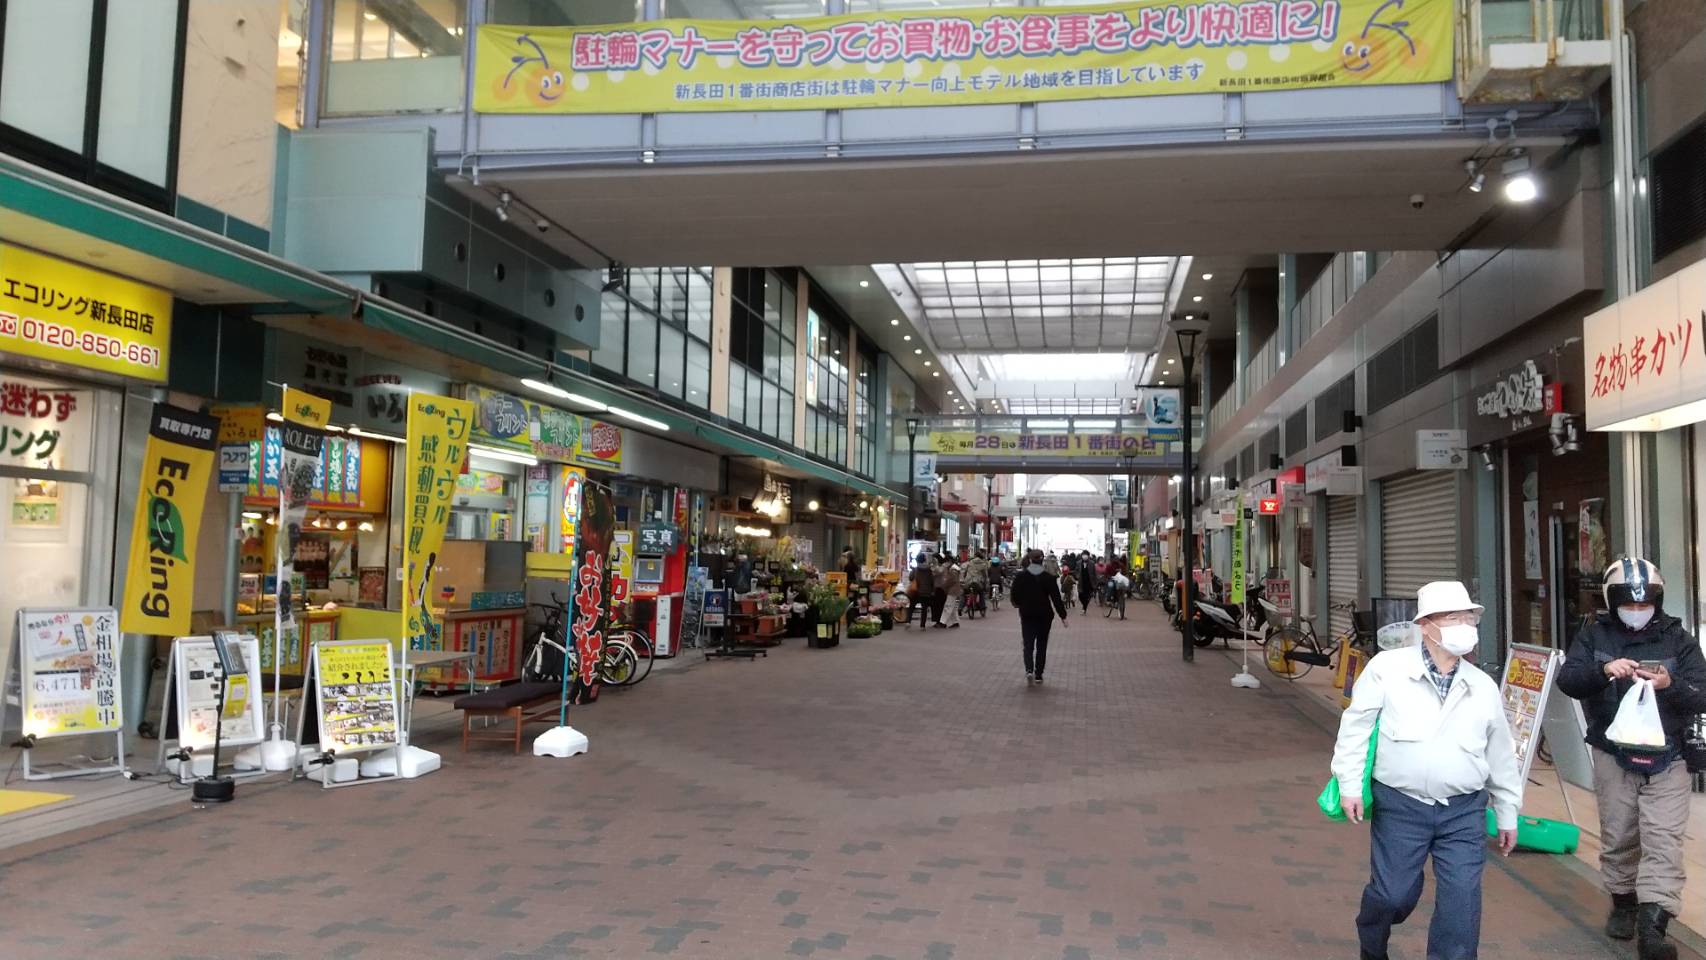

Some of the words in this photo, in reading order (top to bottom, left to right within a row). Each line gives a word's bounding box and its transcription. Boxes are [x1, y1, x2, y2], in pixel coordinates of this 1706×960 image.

[674, 61, 1204, 100] 新長田1番街商店街は駐輪マナー向上モデル地域を目指しています
[4, 278, 155, 335] エコリング新長田店
[22, 319, 161, 367] 0120-850-661
[1591, 318, 1693, 398] 名物串カツ
[0, 382, 77, 422] 迷わず
[159, 415, 213, 442] 買取専門店
[432, 407, 467, 525] ウルウル
[409, 434, 440, 554] 感動買取
[139, 456, 191, 619] EcoRing
[642, 528, 673, 546] 写真
[34, 677, 80, 692] 6,471
[95, 615, 118, 726] 金相場高騰中
